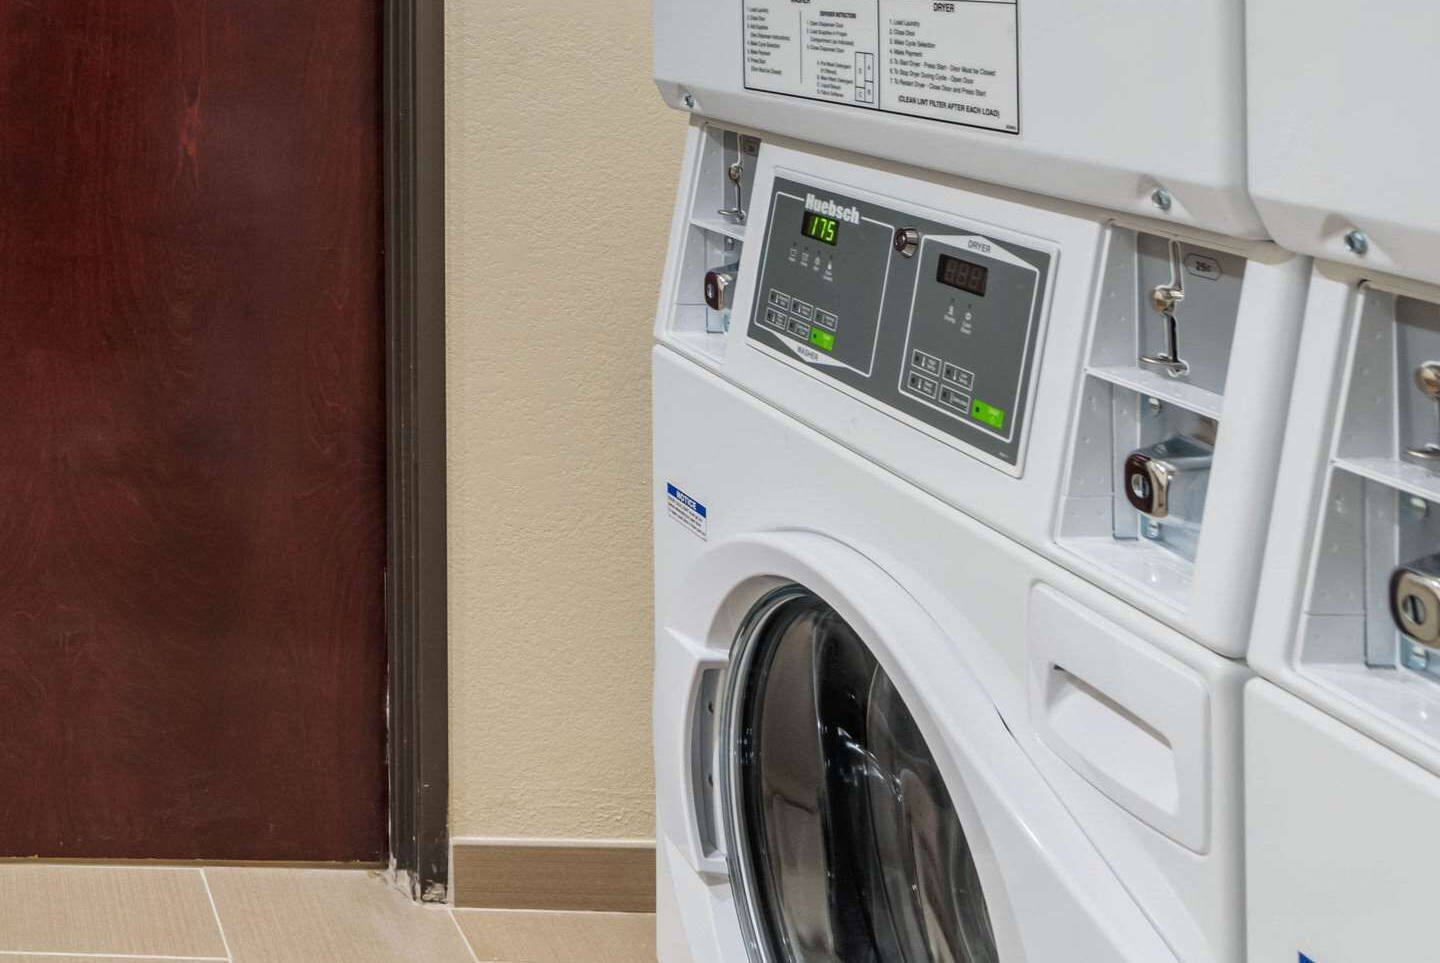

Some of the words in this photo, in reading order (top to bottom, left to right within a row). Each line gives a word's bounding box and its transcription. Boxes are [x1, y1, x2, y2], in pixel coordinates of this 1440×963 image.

[933, 2, 955, 13] DRYER
[929, 99, 946, 109] FILTER
[948, 102, 965, 112] AFTER
[966, 105, 981, 114] EACH
[805, 193, 860, 225] Huebsch
[811, 216, 837, 242] 175
[967, 239, 992, 254] DRYER
